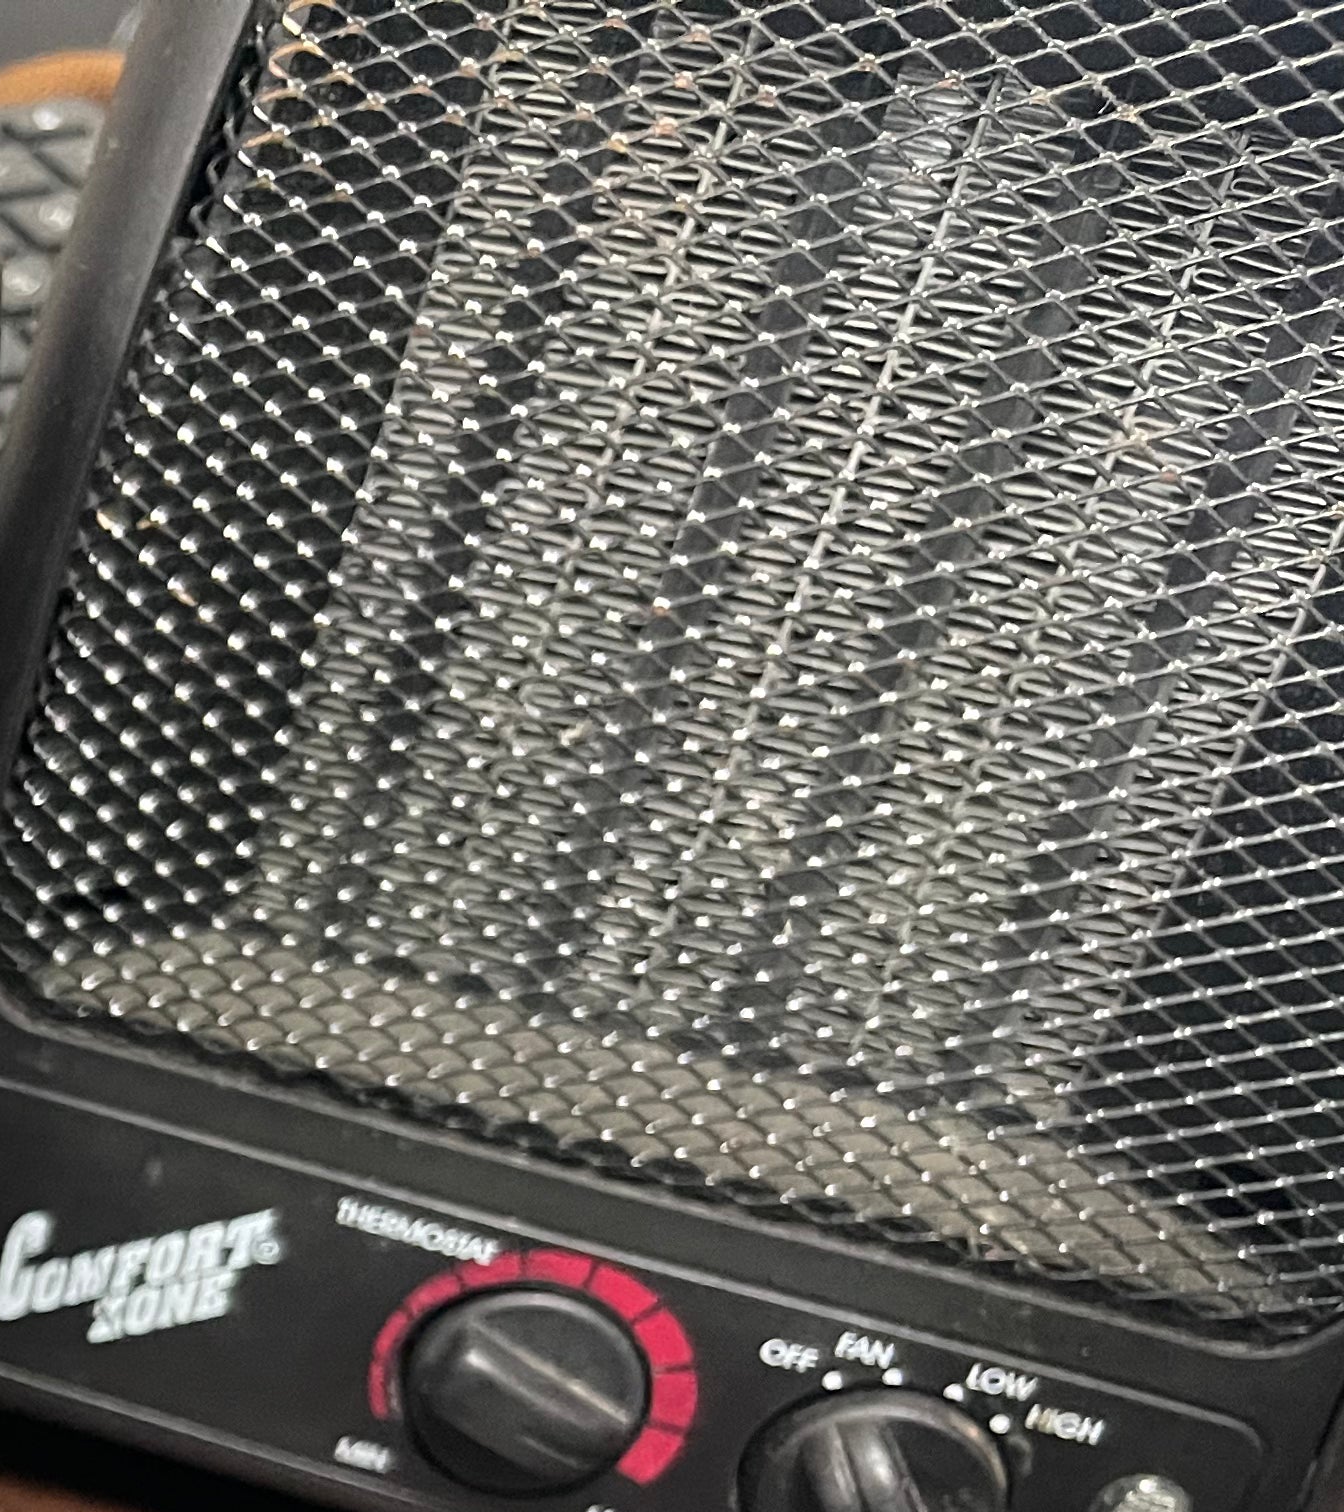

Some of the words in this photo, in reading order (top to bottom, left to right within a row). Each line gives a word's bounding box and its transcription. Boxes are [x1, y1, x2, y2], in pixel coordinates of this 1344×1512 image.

[334, 1195, 500, 1267] THERMOSTAT
[758, 1337, 820, 1373] OFF
[834, 1330, 896, 1369] FAN
[965, 1361, 1039, 1402] LOW
[1024, 1402, 1107, 1446] HIGH
